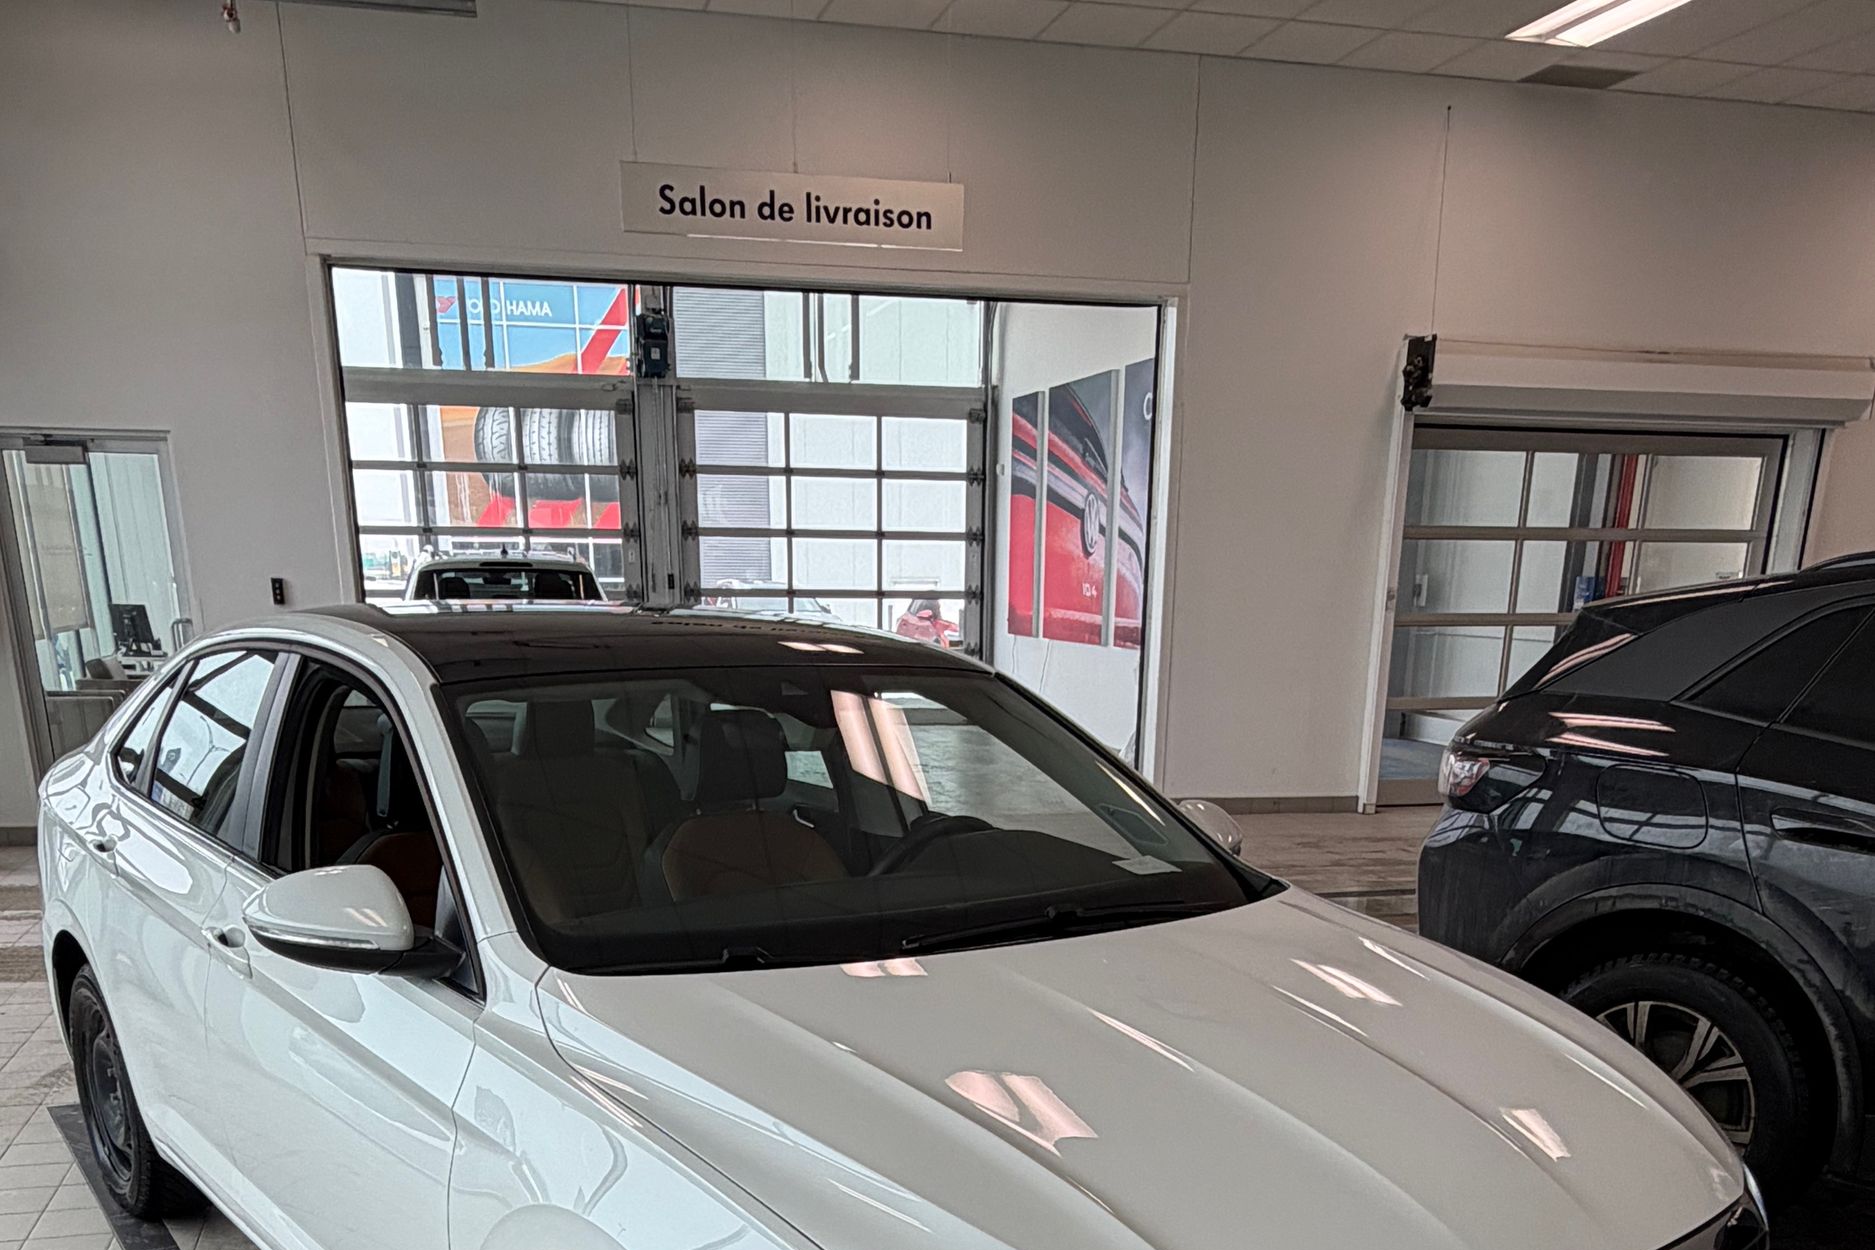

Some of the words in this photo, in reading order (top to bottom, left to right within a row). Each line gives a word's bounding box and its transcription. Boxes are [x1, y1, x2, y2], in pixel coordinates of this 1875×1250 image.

[658, 184, 746, 219] Salon
[757, 189, 795, 222] de
[805, 191, 933, 230] livraison
